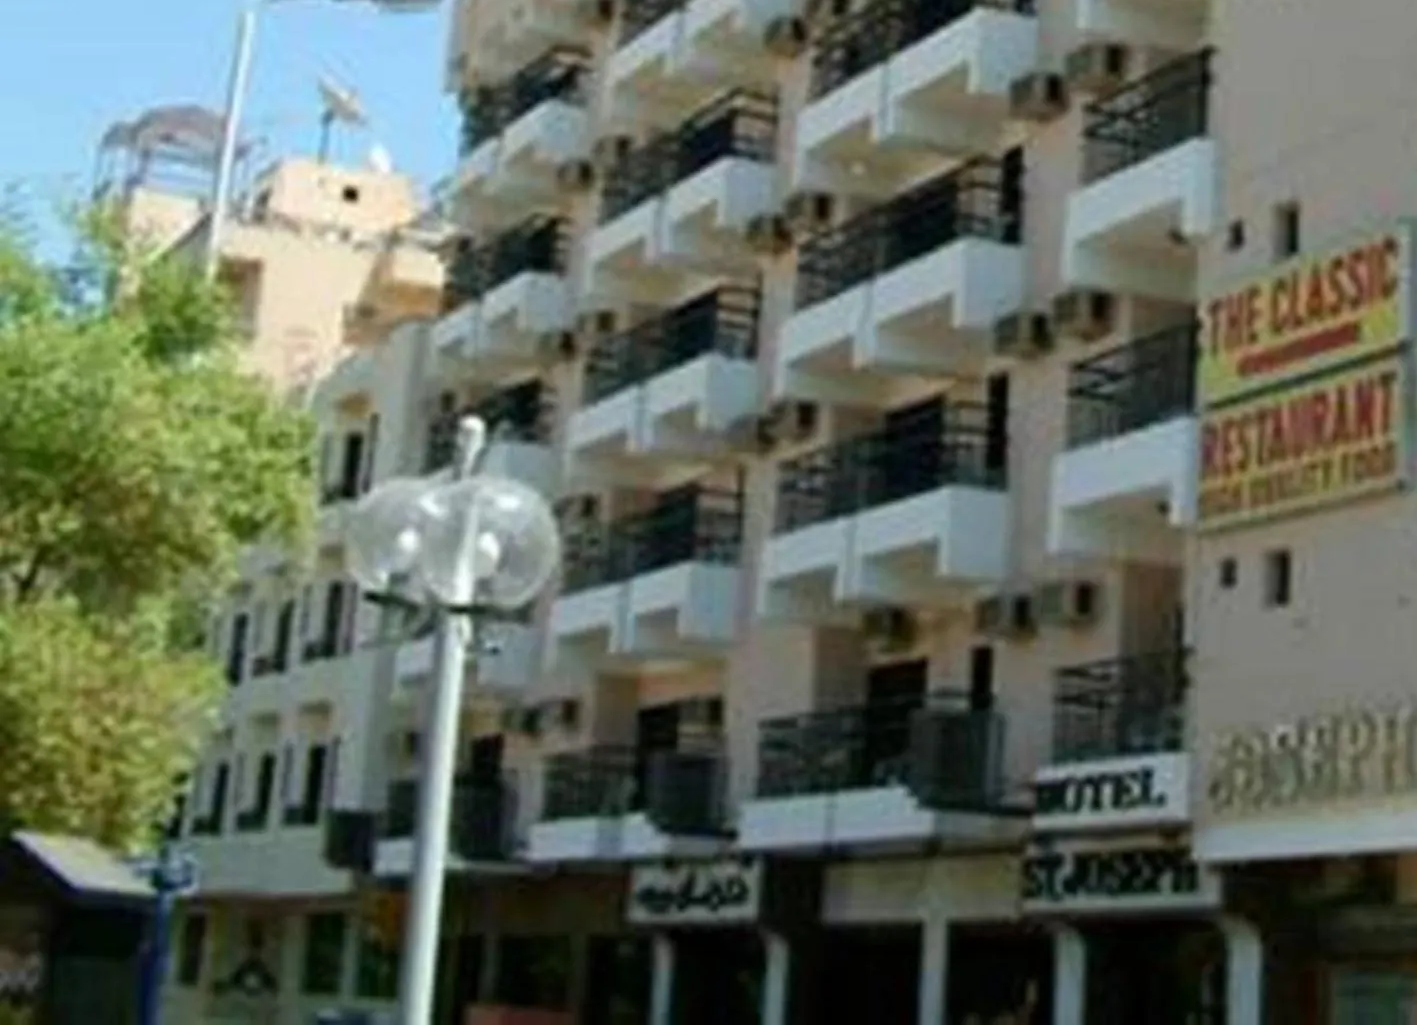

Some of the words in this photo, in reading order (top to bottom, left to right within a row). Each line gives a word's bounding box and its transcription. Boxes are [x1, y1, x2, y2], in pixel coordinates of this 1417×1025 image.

[1206, 287, 1260, 355] THE
[1270, 233, 1399, 331] CLASSIC
[1202, 372, 1399, 474] RESTAURANT
[1036, 766, 1168, 814] HOTEL
